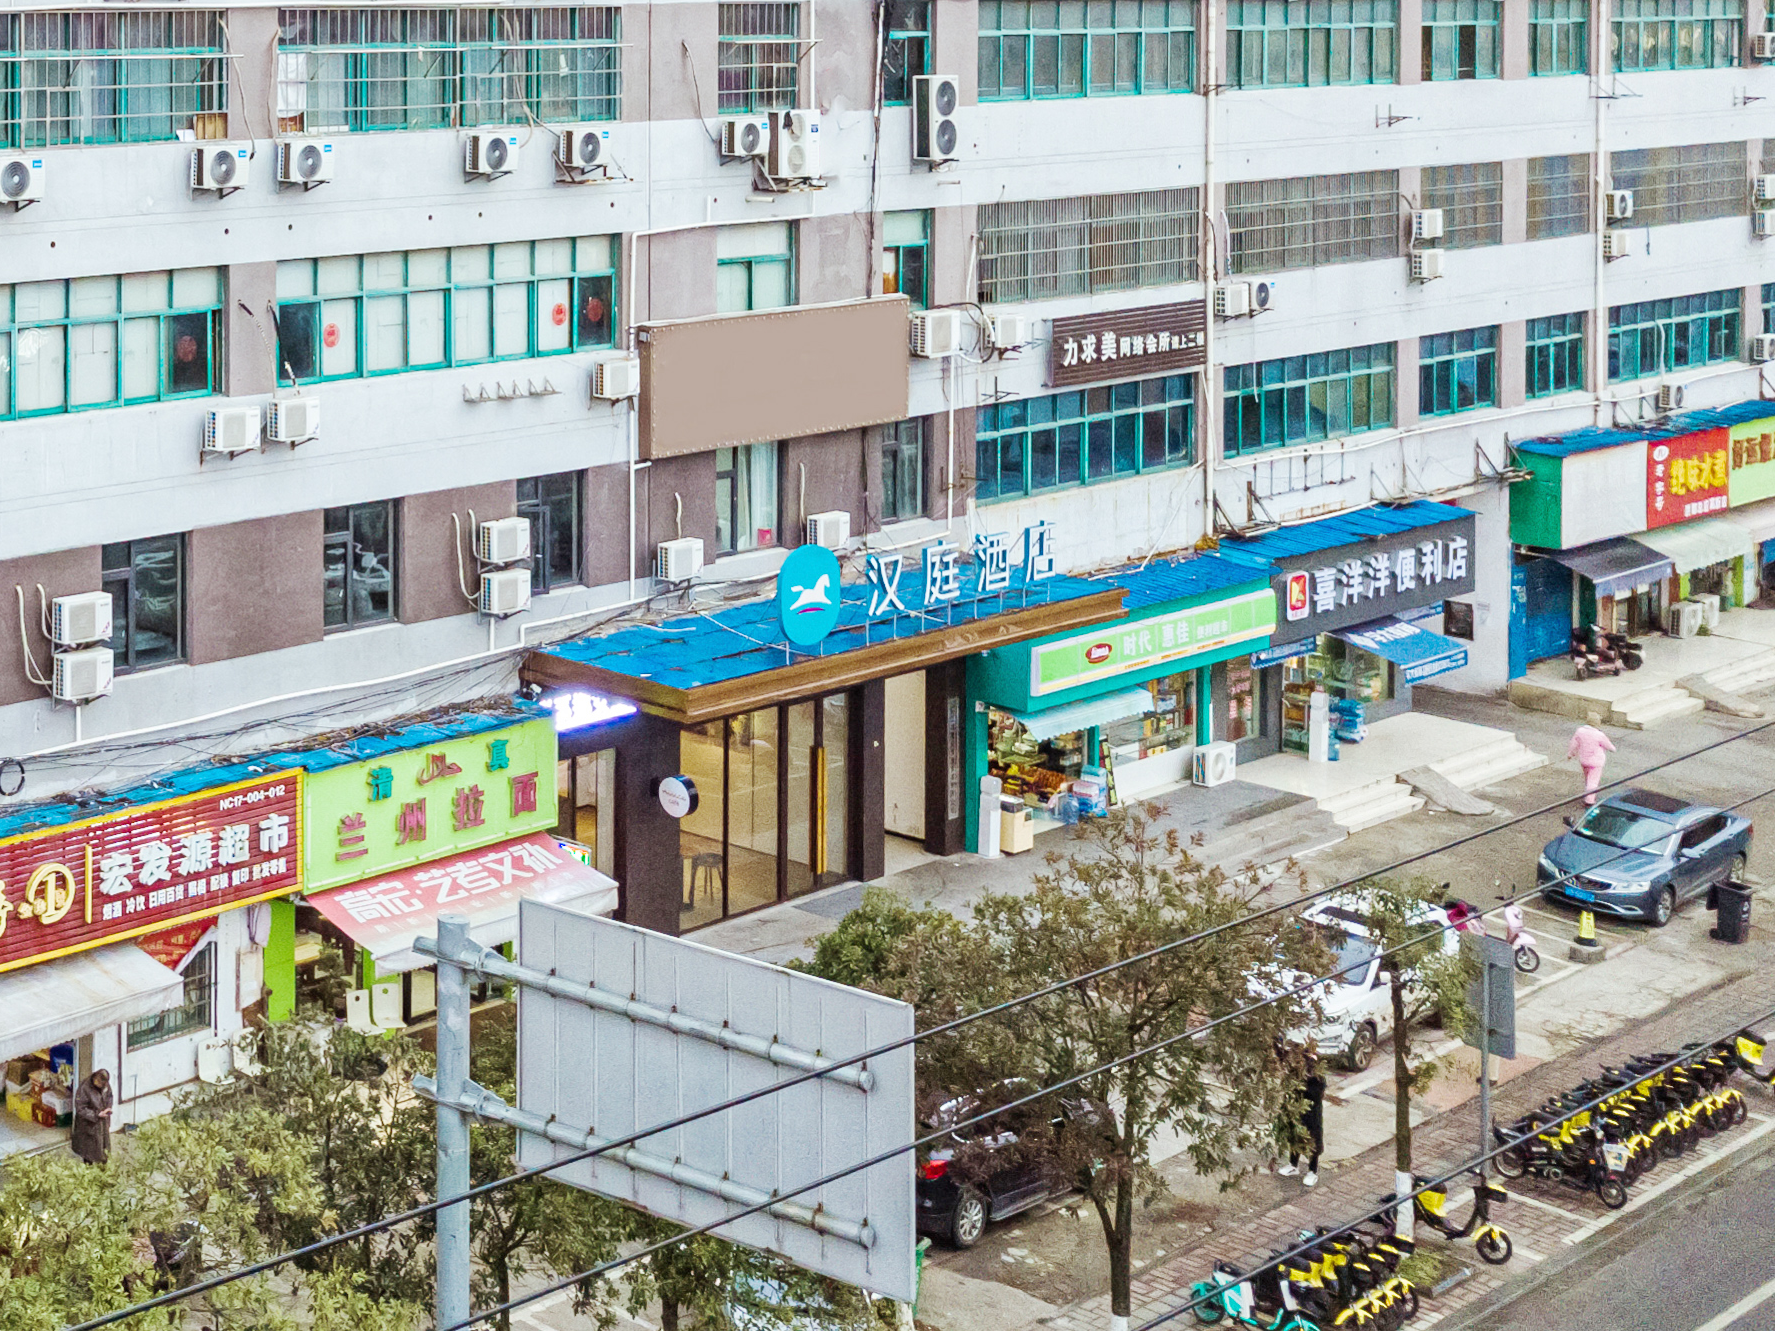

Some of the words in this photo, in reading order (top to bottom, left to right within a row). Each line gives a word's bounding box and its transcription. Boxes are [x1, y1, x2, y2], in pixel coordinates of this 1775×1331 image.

[866, 520, 1057, 616] 汉庭酒店
[1314, 536, 1468, 613] 喜洋洋便利店
[219, 785, 286, 811] NC17-004-012
[336, 771, 539, 862] 兰州拉面
[100, 813, 290, 896] 宏发源超市
[149, 884, 184, 909] 日用百货
